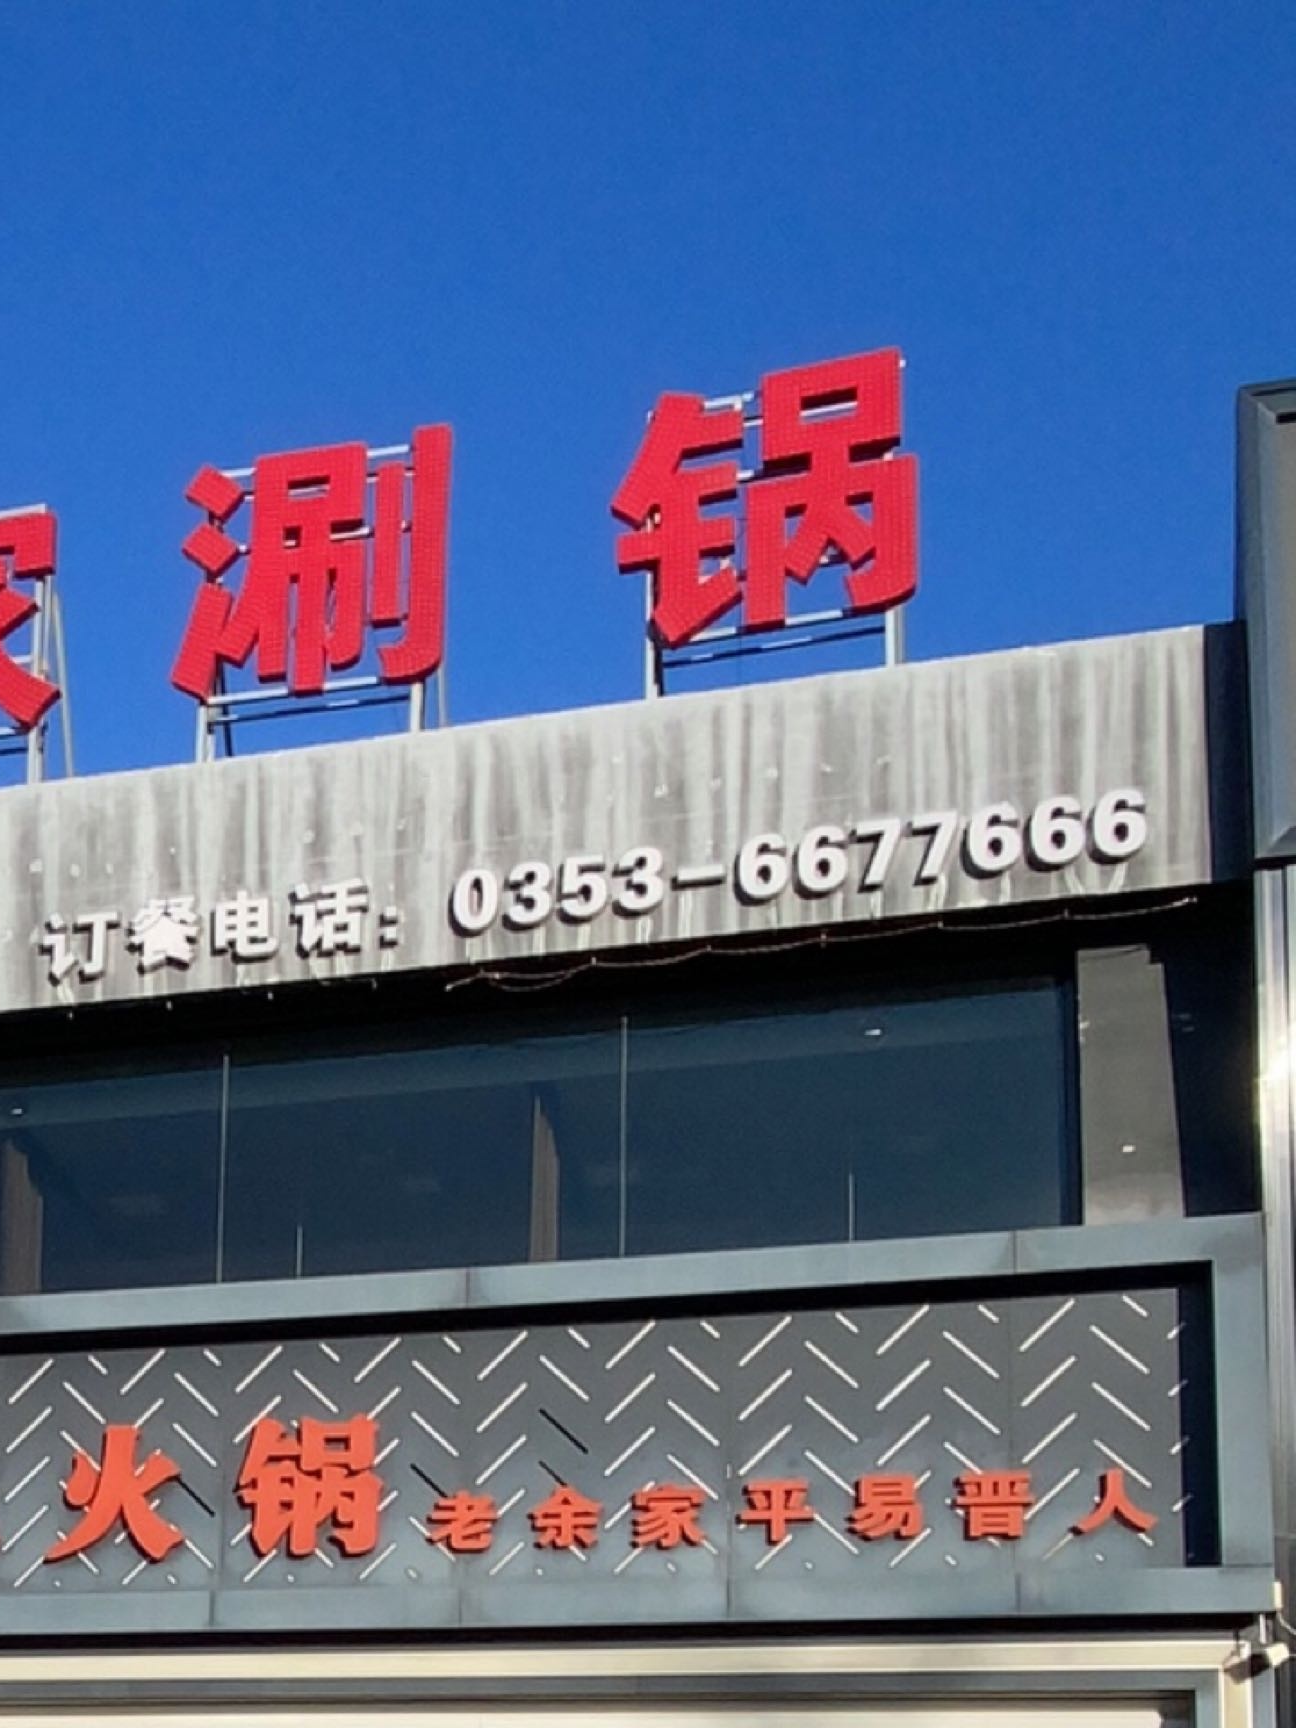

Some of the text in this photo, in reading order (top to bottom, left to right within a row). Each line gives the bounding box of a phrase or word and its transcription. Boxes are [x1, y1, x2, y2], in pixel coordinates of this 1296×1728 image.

[449, 787, 1149, 937] 0353-6677666
[427, 1469, 1158, 1552] 老余家平易晋人
